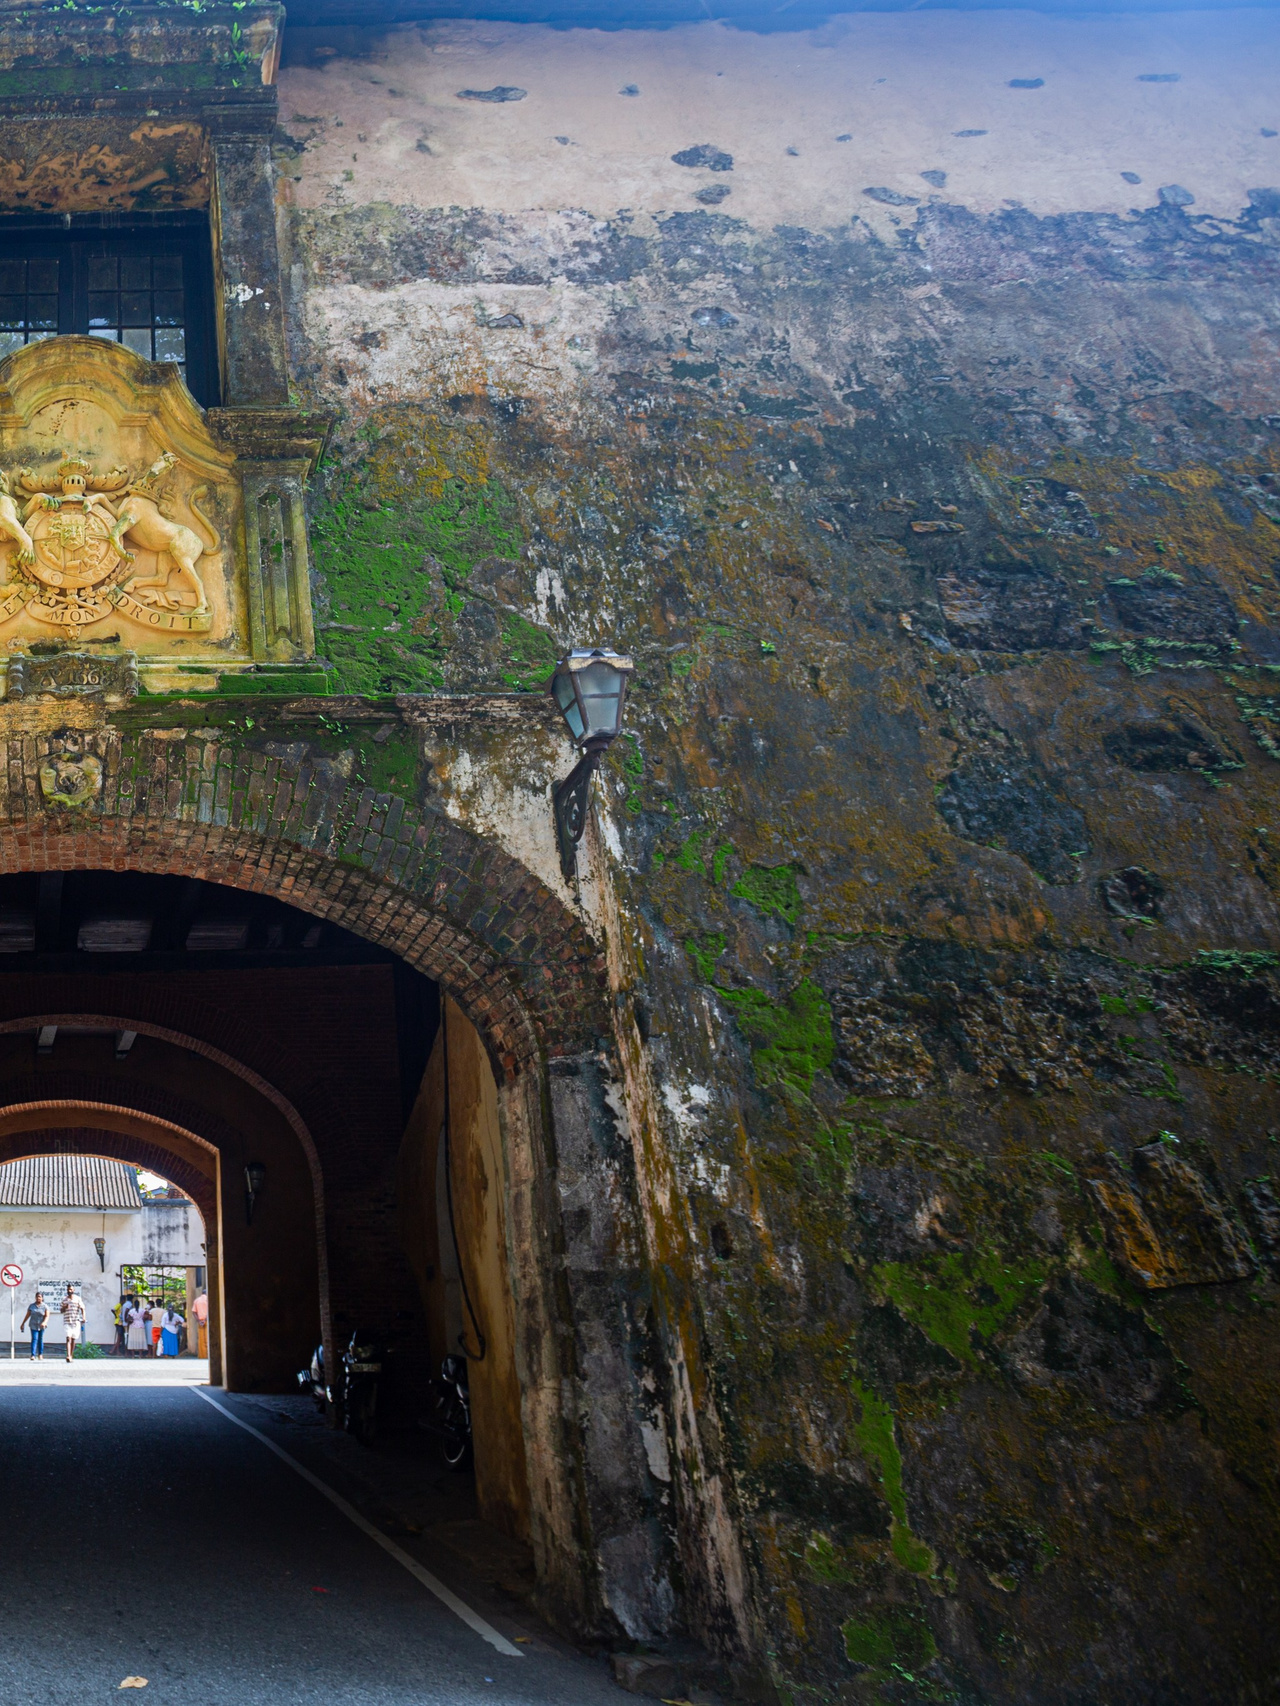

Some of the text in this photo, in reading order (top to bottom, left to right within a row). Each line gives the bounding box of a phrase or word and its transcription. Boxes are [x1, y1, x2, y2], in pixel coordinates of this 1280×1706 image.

[3, 590, 27, 616] ET
[50, 609, 95, 622] MON
[116, 593, 199, 629] DROIT
